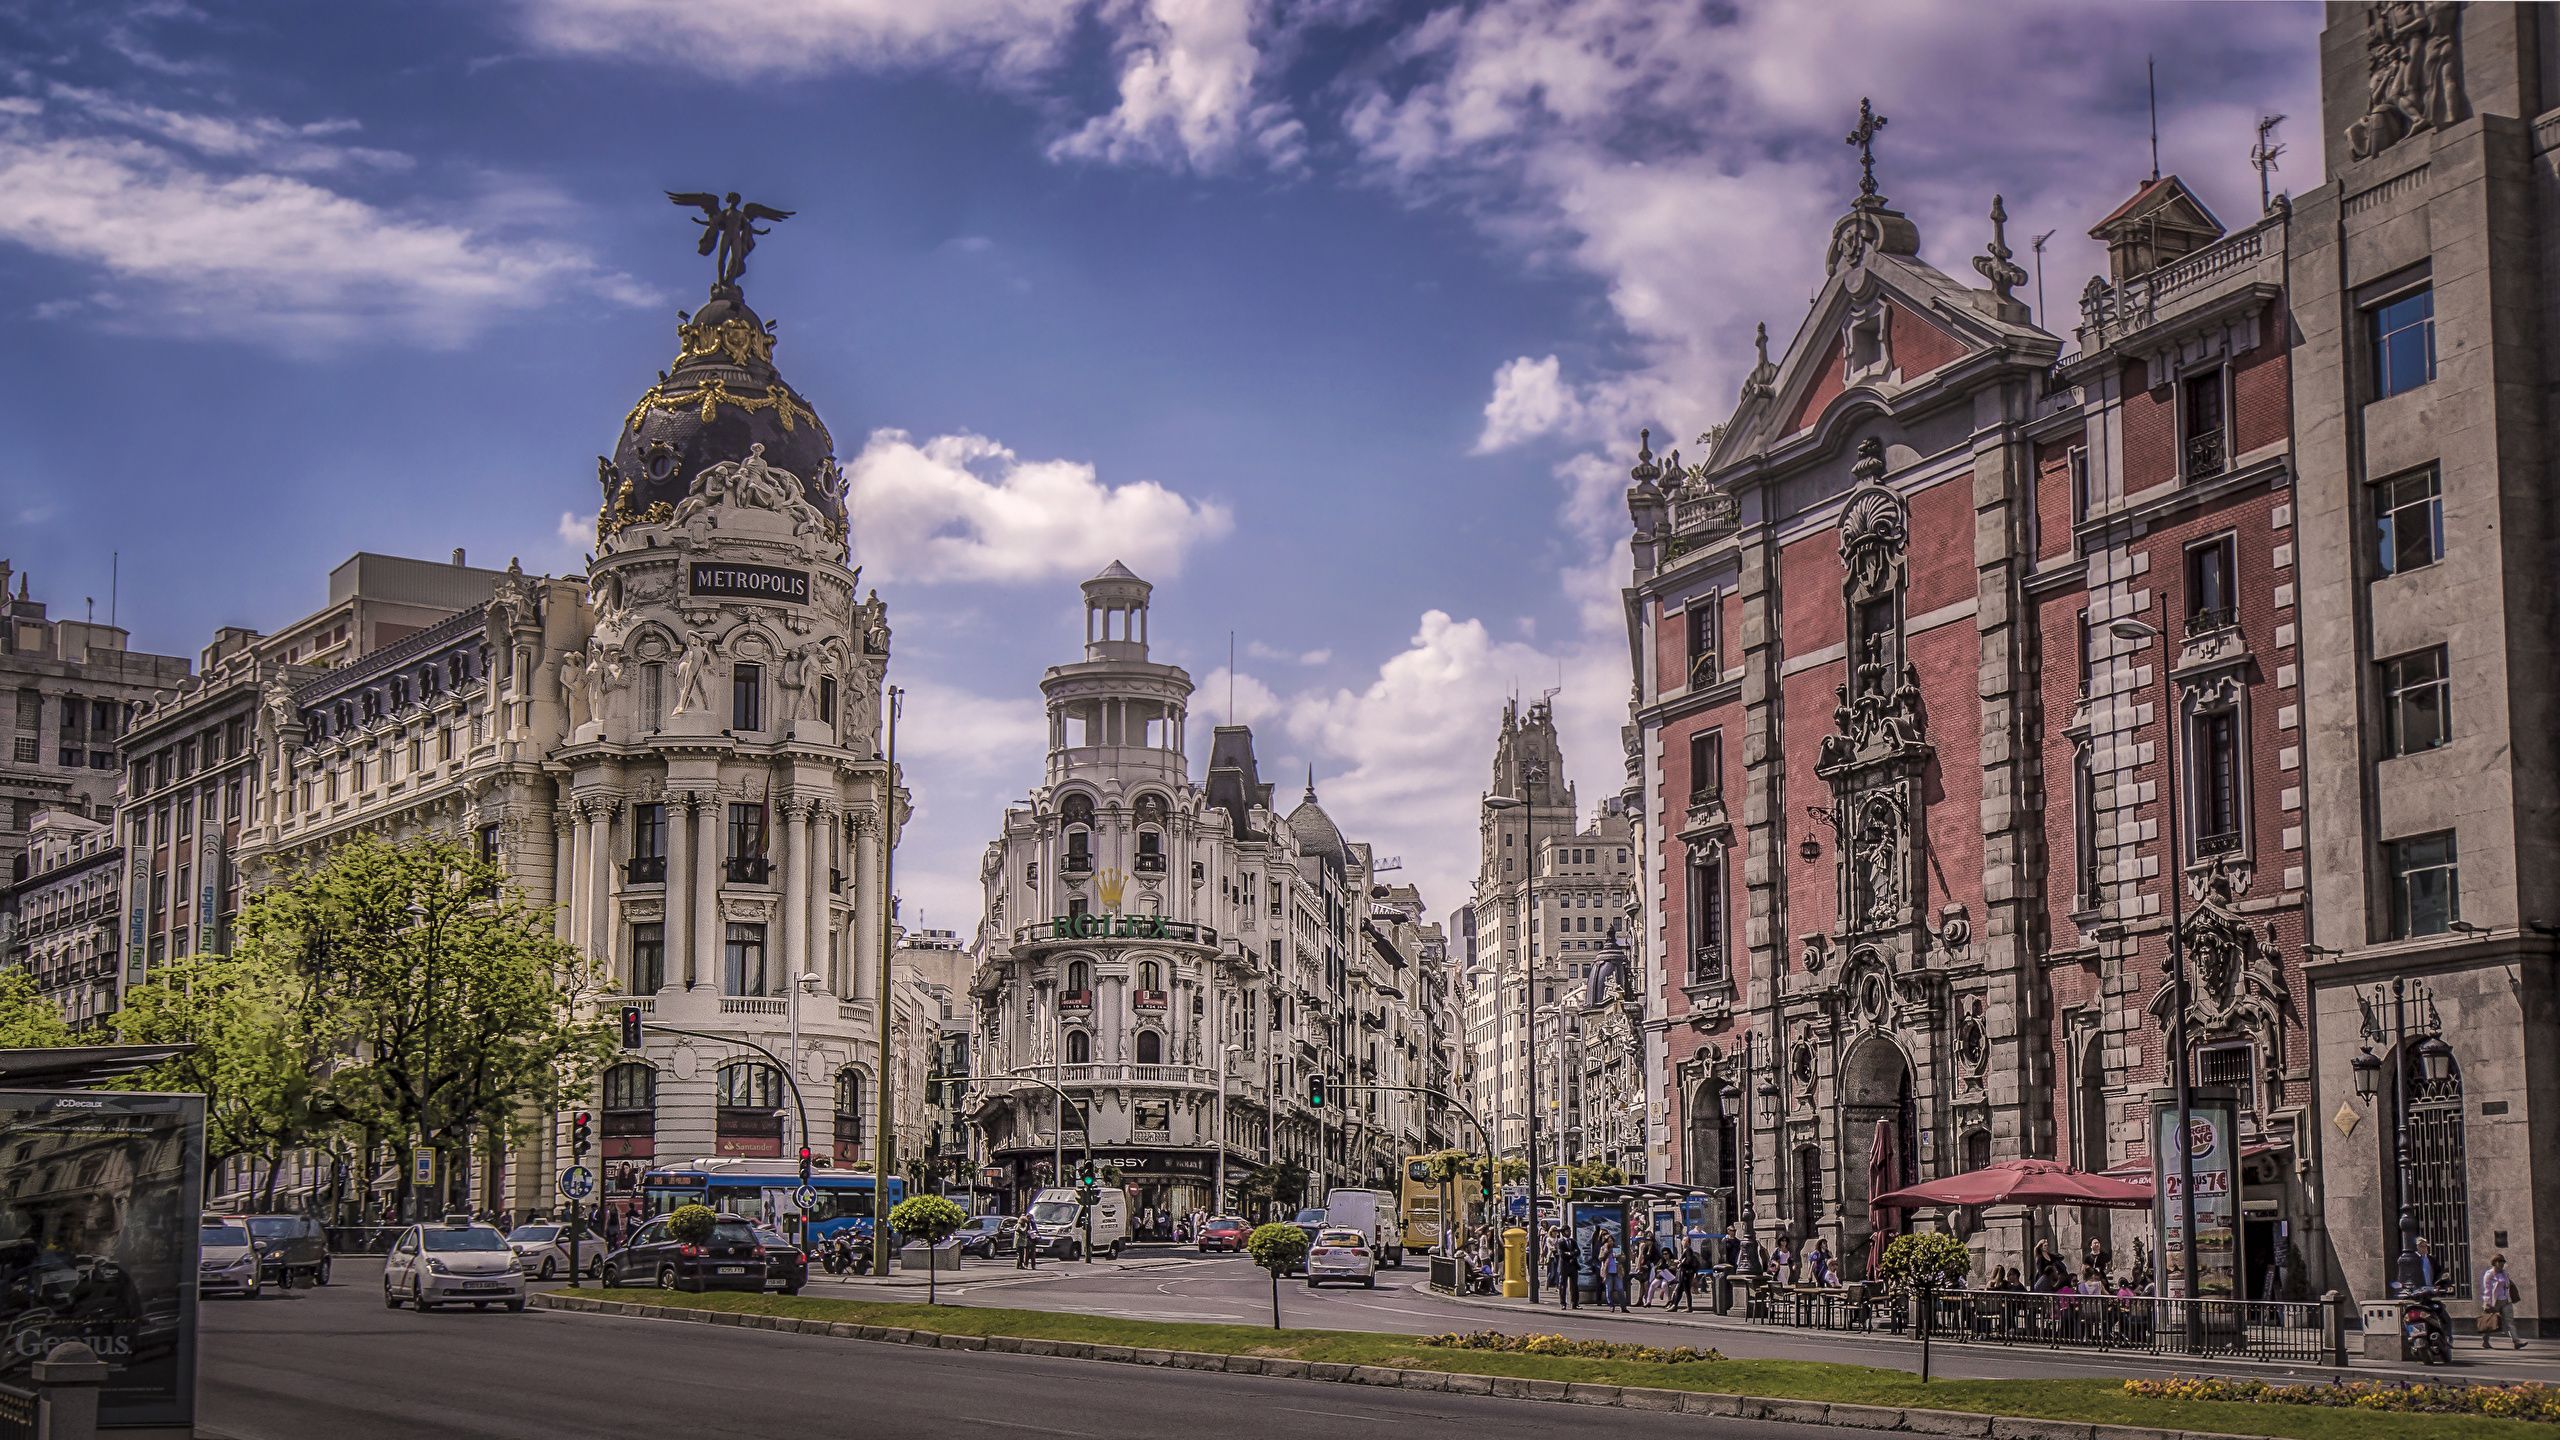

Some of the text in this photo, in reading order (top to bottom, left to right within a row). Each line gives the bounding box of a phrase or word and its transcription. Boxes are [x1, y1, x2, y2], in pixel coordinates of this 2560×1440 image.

[698, 570, 805, 595] METROPOLIS
[200, 886, 216, 952] hay salida
[1052, 912, 1172, 940] ROLEX
[131, 908, 145, 970] hay salida
[56, 1099, 102, 1108] JCDecaux
[2191, 1125, 2211, 1136] RGER
[735, 1142, 772, 1151] Santander
[2167, 1176, 2177, 1194] 2
[2207, 1172, 2227, 1191] 7€
